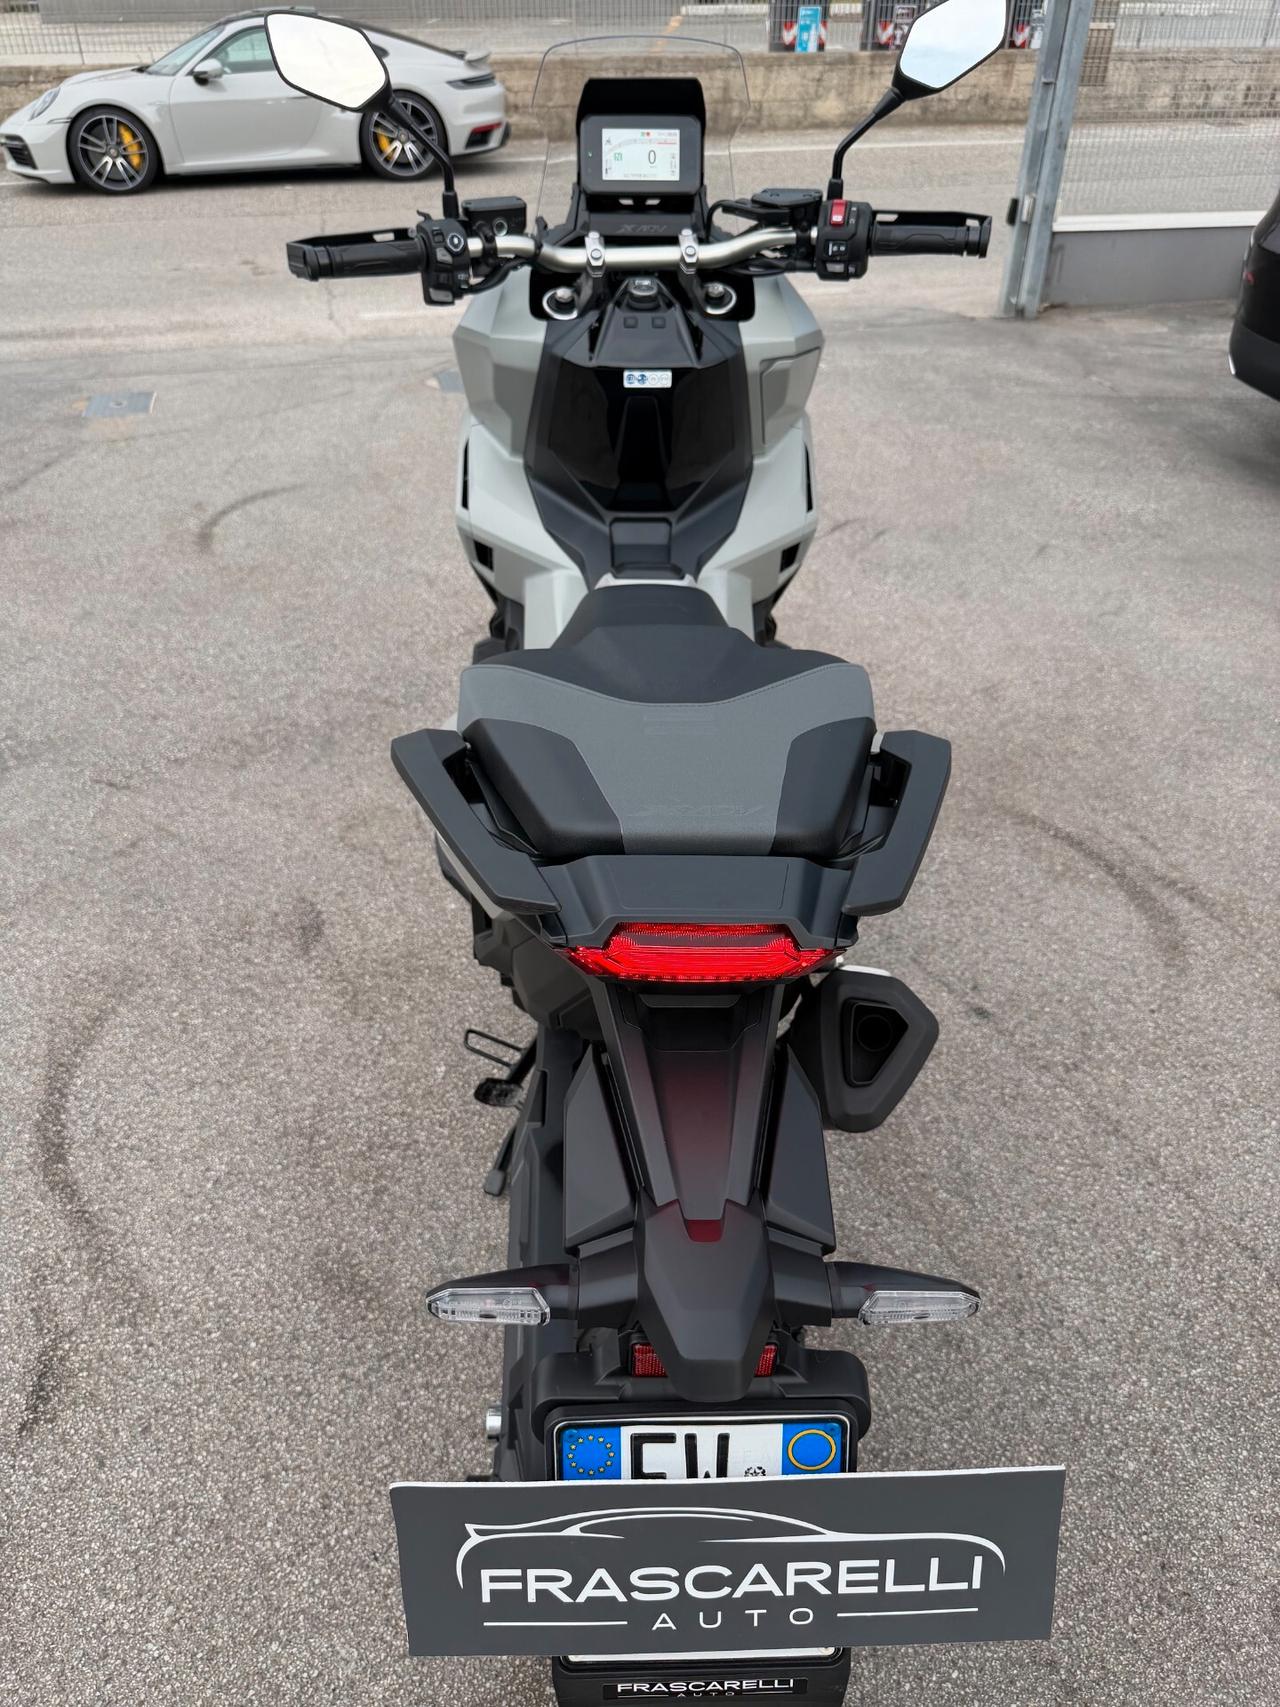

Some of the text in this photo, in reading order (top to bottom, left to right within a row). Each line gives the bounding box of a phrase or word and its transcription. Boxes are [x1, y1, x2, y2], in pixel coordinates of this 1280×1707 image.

[481, 1556, 983, 1603] FRASCARELLI
[652, 1607, 814, 1631] AUTO
[617, 1679, 794, 1692] FRASCARELLI
